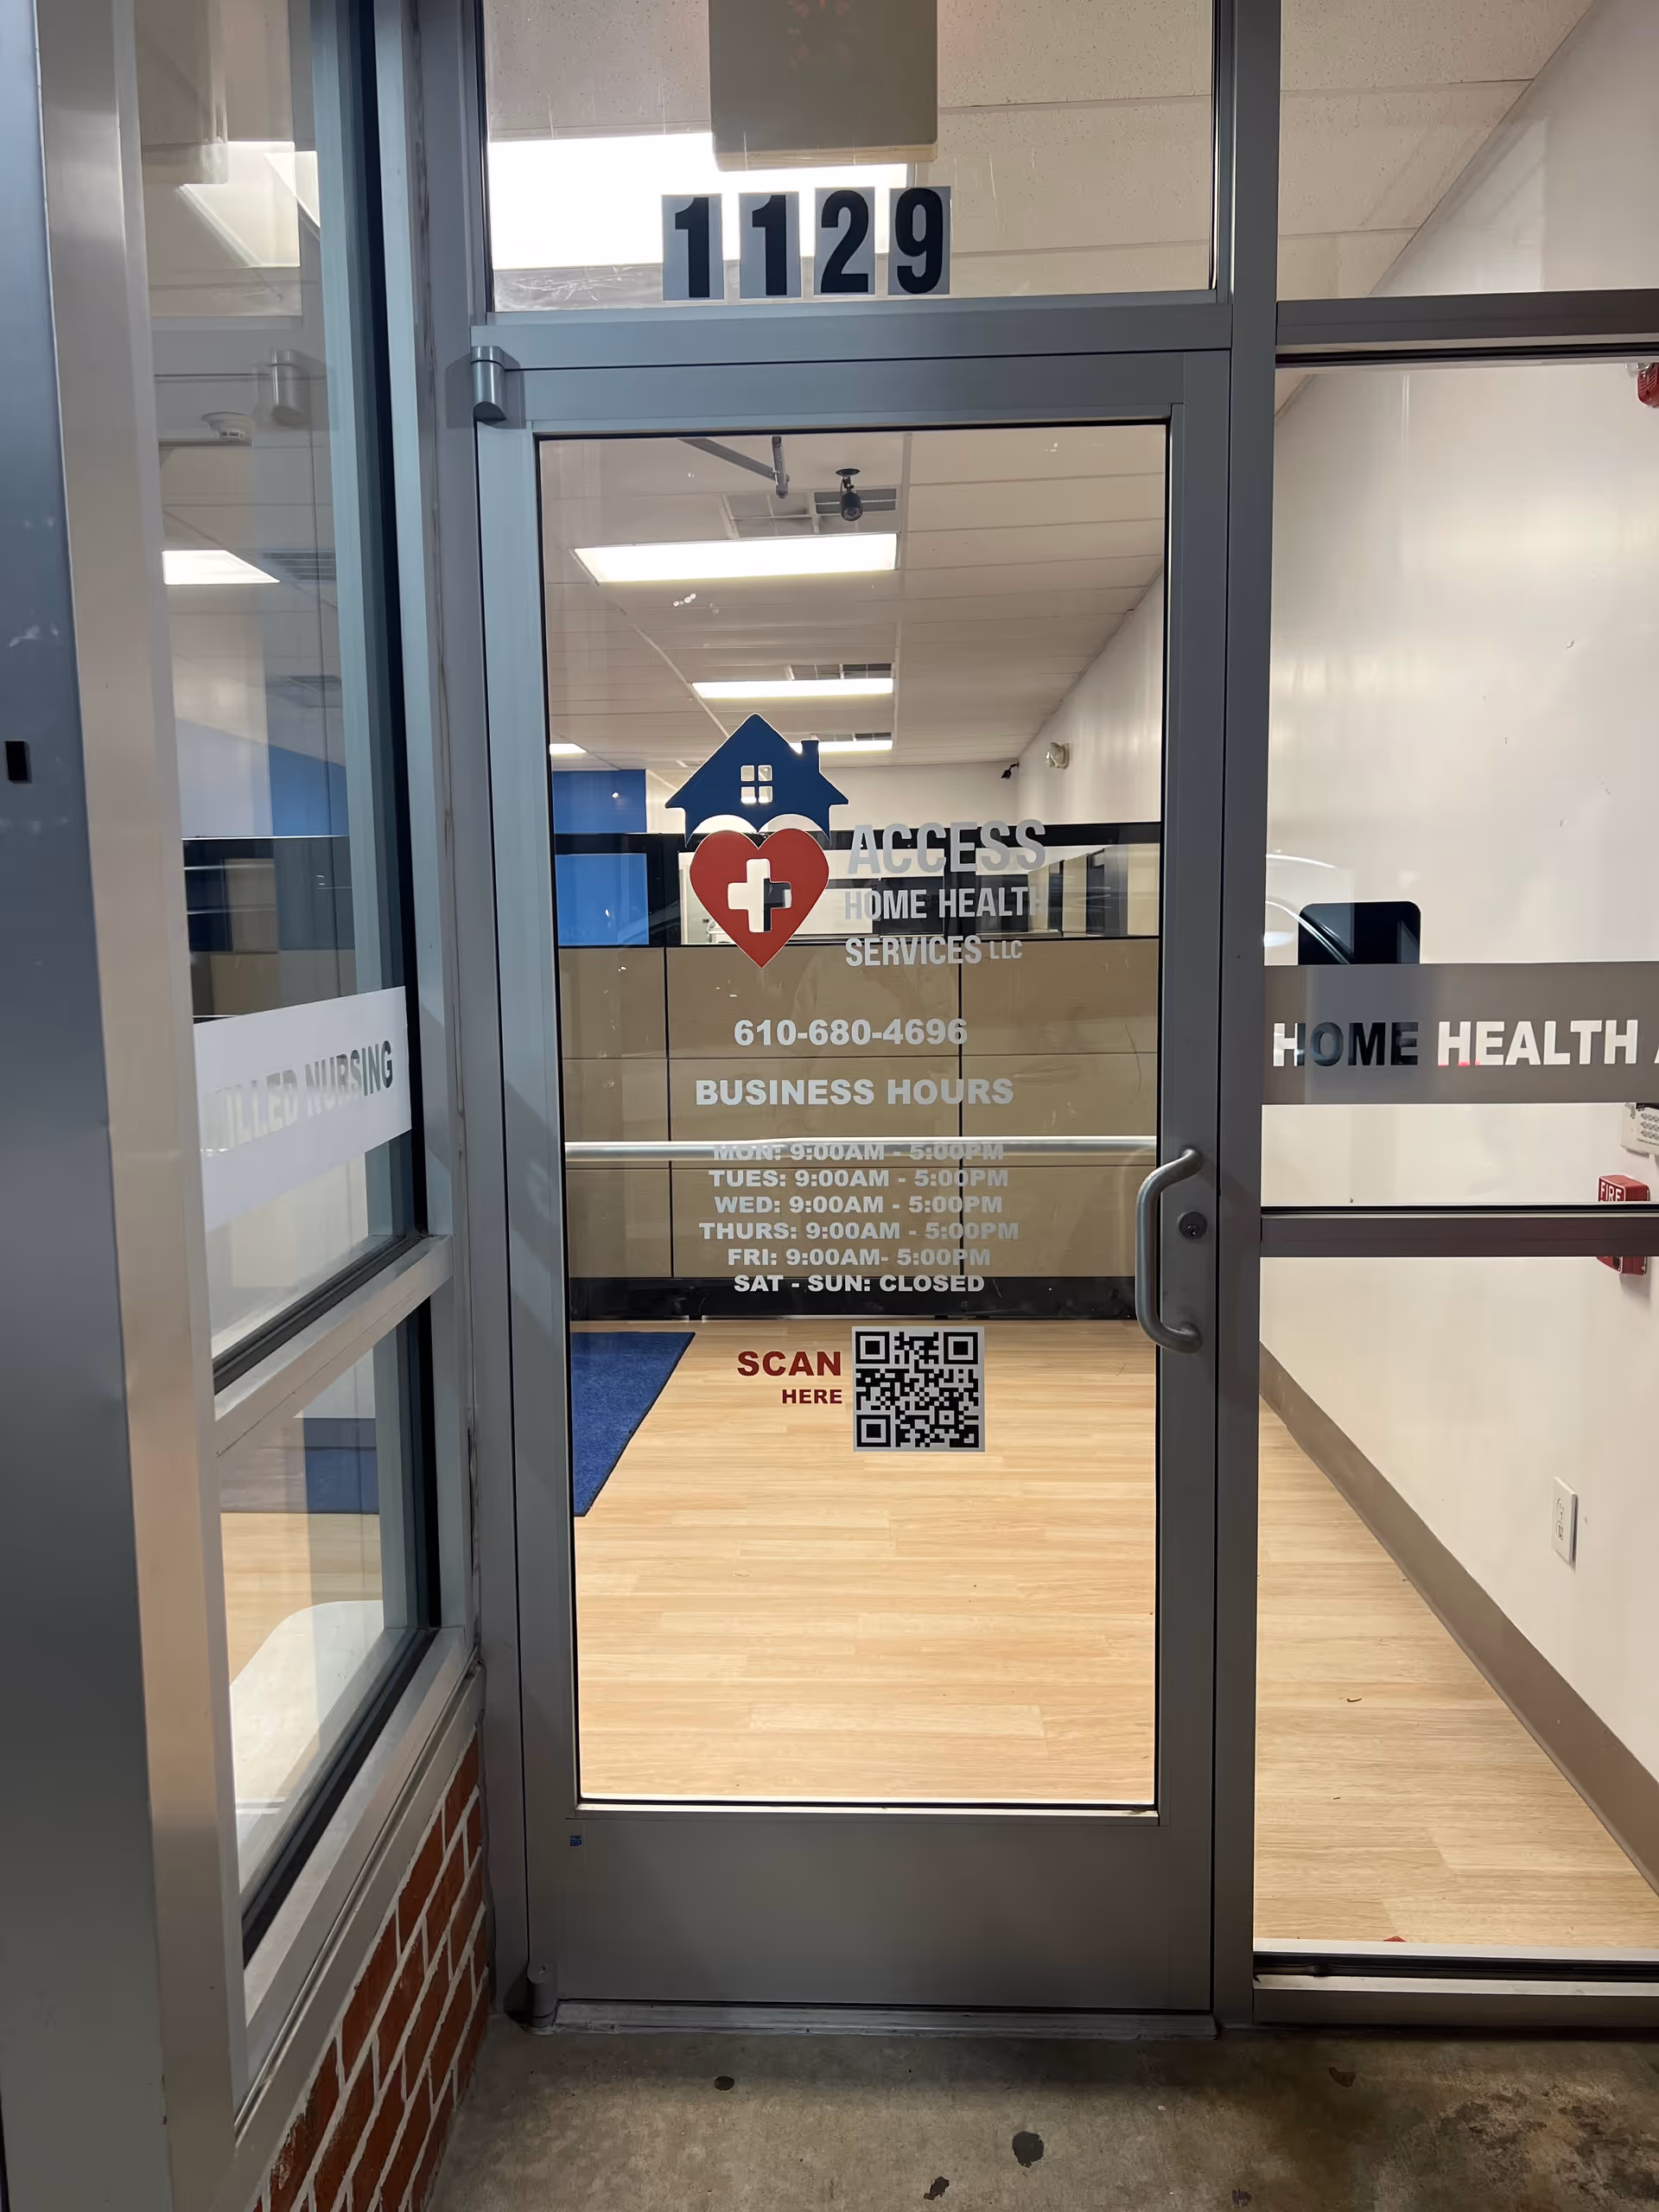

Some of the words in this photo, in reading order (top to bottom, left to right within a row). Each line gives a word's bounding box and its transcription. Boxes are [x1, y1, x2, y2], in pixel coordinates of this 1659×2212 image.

[675, 188, 944, 298] 1129
[847, 819, 1046, 874] ACCESS
[845, 888, 928, 920] HOME
[845, 935, 982, 967] SERVICES
[989, 939, 1023, 961] LLC
[734, 1018, 969, 1046] 610-680-4696
[1272, 1020, 1420, 1067] HOME
[1437, 1019, 1639, 1066] HEALTH
[305, 1039, 394, 1116] NURSING
[696, 1079, 875, 1106] BUSINESS
[887, 1077, 1014, 1105] HOURS
[713, 1144, 781, 1161] MON:
[790, 1143, 885, 1161] 9:00AM
[909, 1143, 1004, 1160] 5:00PM
[709, 1170, 786, 1187] TUES:
[794, 1169, 889, 1187] 9:00AM
[914, 1169, 1009, 1187] 5:00PM
[1599, 1180, 1623, 1202] FIRE
[714, 1196, 781, 1214] WED:
[789, 1196, 884, 1214] 9:00AM
[908, 1196, 1003, 1213] 5:00PM
[699, 1222, 798, 1240] THURS:
[805, 1222, 900, 1240] 9:00AM
[925, 1222, 1020, 1240] 5:00PM
[728, 1249, 778, 1266] FRI:
[897, 1248, 991, 1266] 5:00PM
[734, 1274, 784, 1293] SAT
[807, 1274, 871, 1293] SUN:
[879, 1274, 985, 1293] CLOSED
[736, 1351, 842, 1376] SCAN
[781, 1389, 842, 1404] HERE
